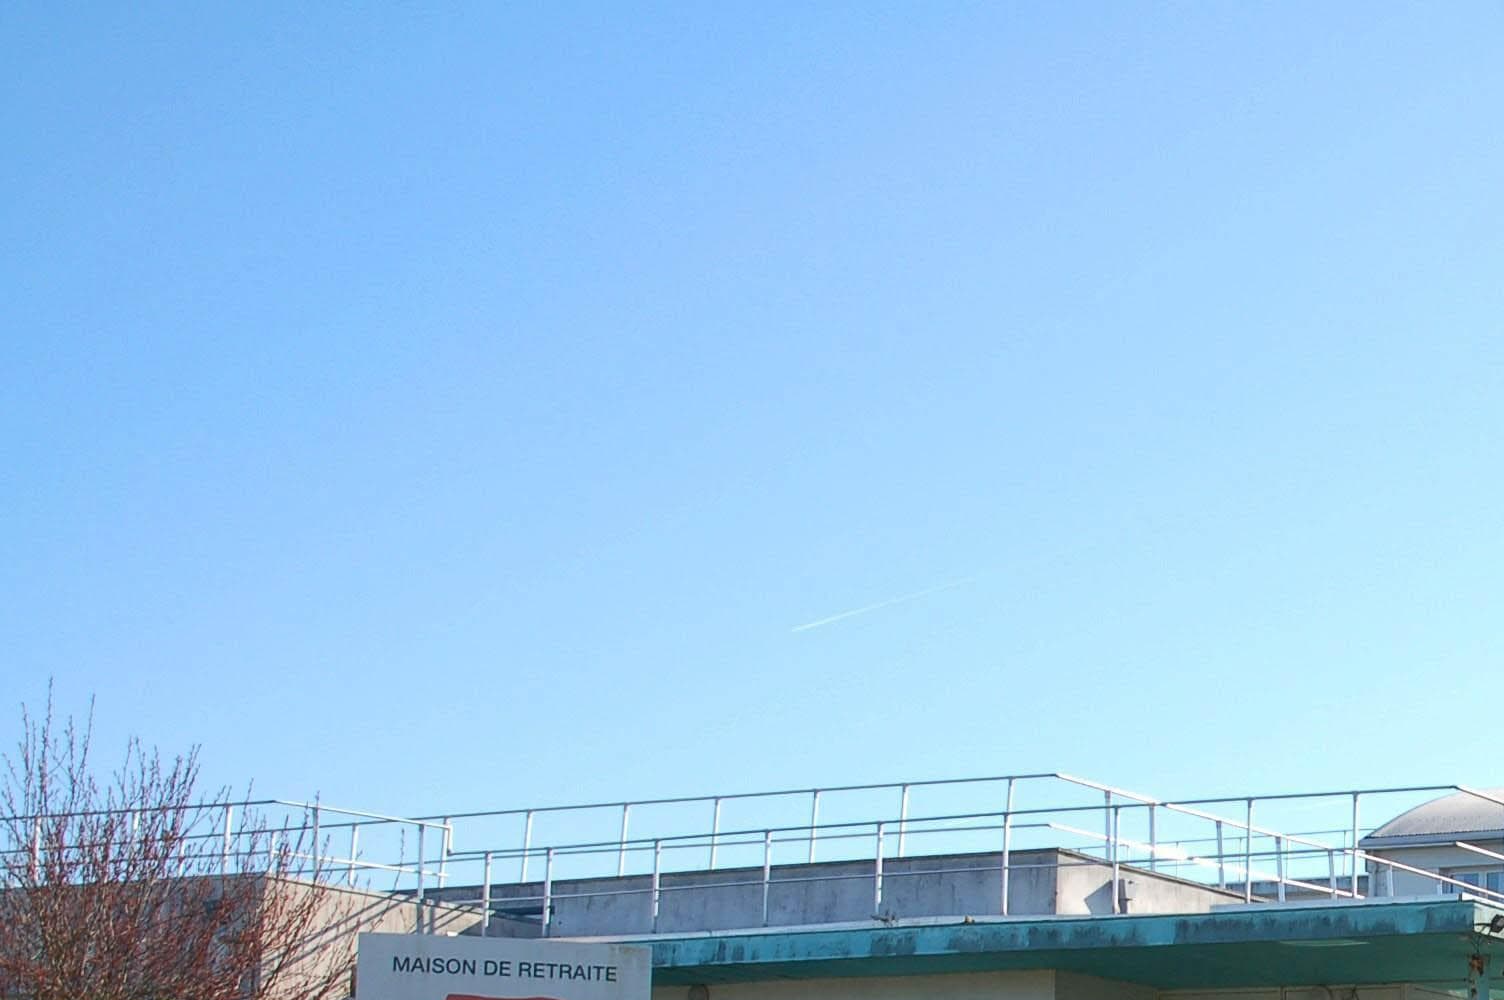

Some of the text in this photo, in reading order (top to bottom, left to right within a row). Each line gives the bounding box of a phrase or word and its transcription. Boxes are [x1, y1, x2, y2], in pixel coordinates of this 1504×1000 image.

[392, 956, 617, 982] MAISON DE RETRAITE
